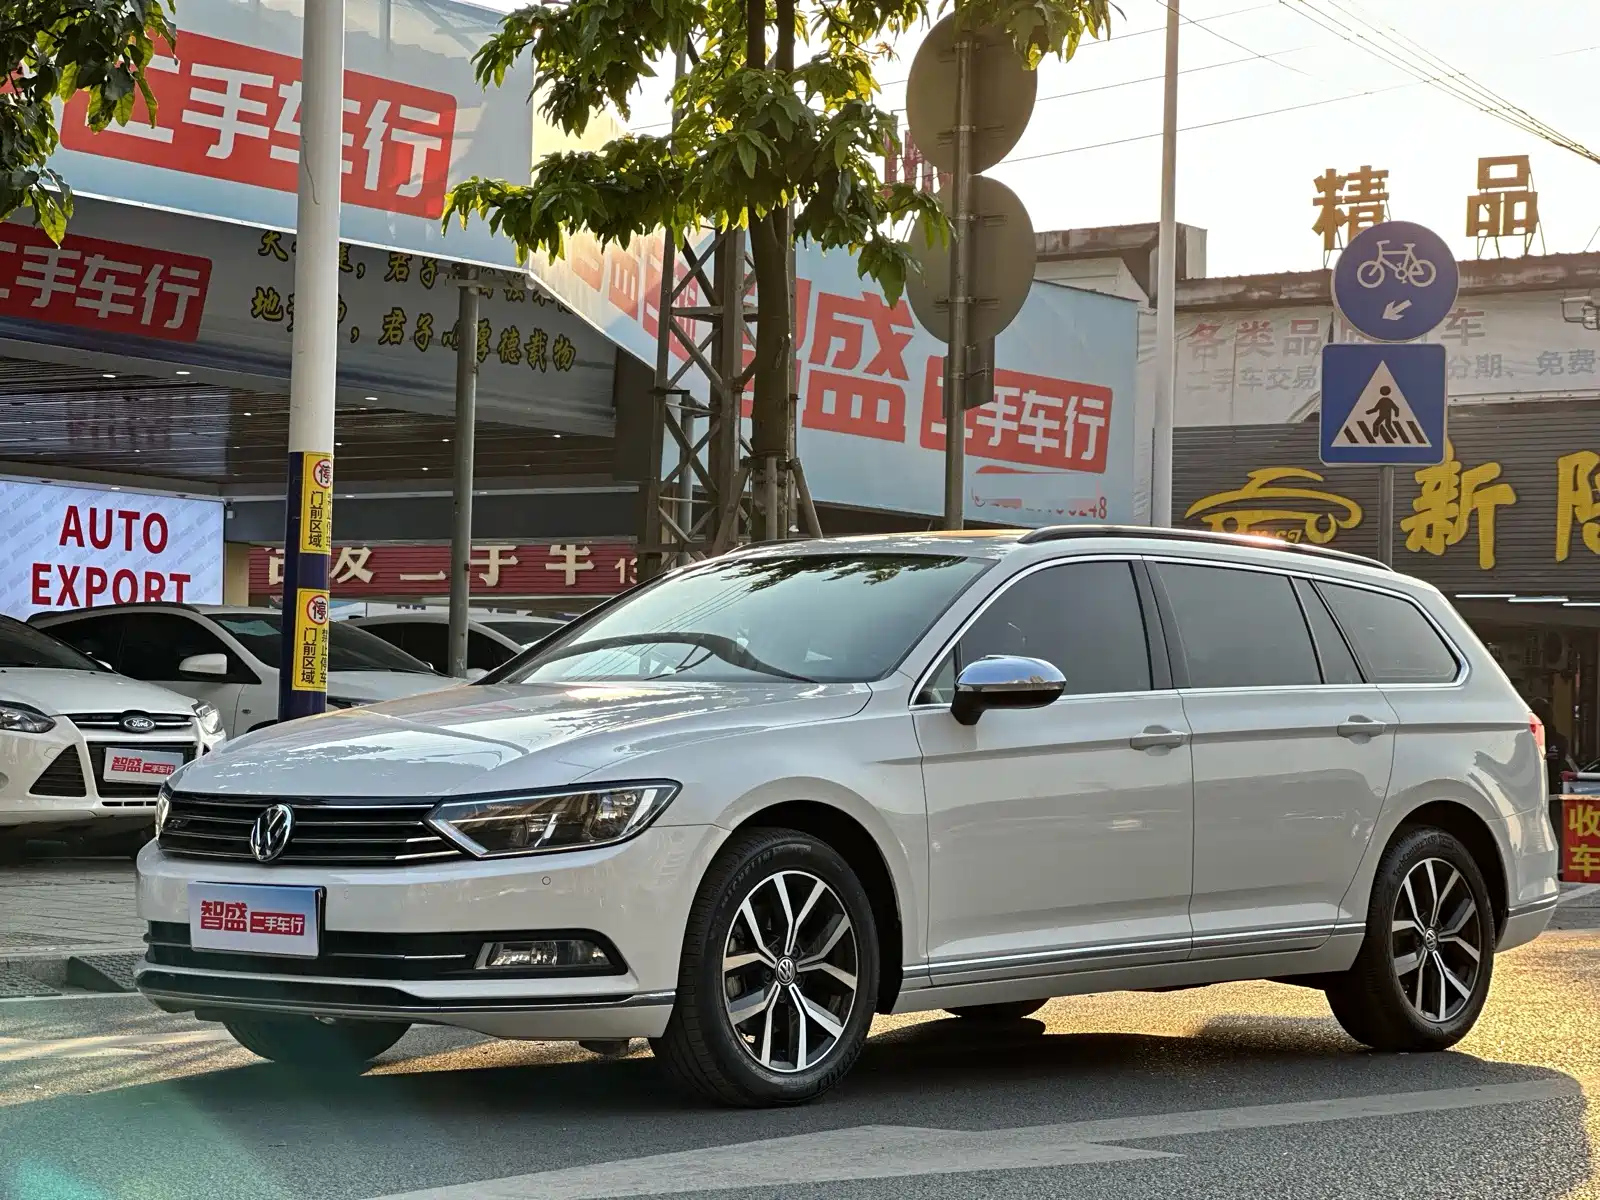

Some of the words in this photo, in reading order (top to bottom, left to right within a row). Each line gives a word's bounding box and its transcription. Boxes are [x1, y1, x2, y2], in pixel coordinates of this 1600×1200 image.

[0, 242, 200, 329] 手车行
[59, 505, 169, 554] AUTO
[308, 490, 324, 548] 门前区域
[32, 562, 191, 608] EXPORT
[301, 627, 318, 685] 门前区域
[111, 756, 143, 773] 智盛
[200, 900, 248, 932] 智盛
[252, 914, 304, 933] 二手车行
